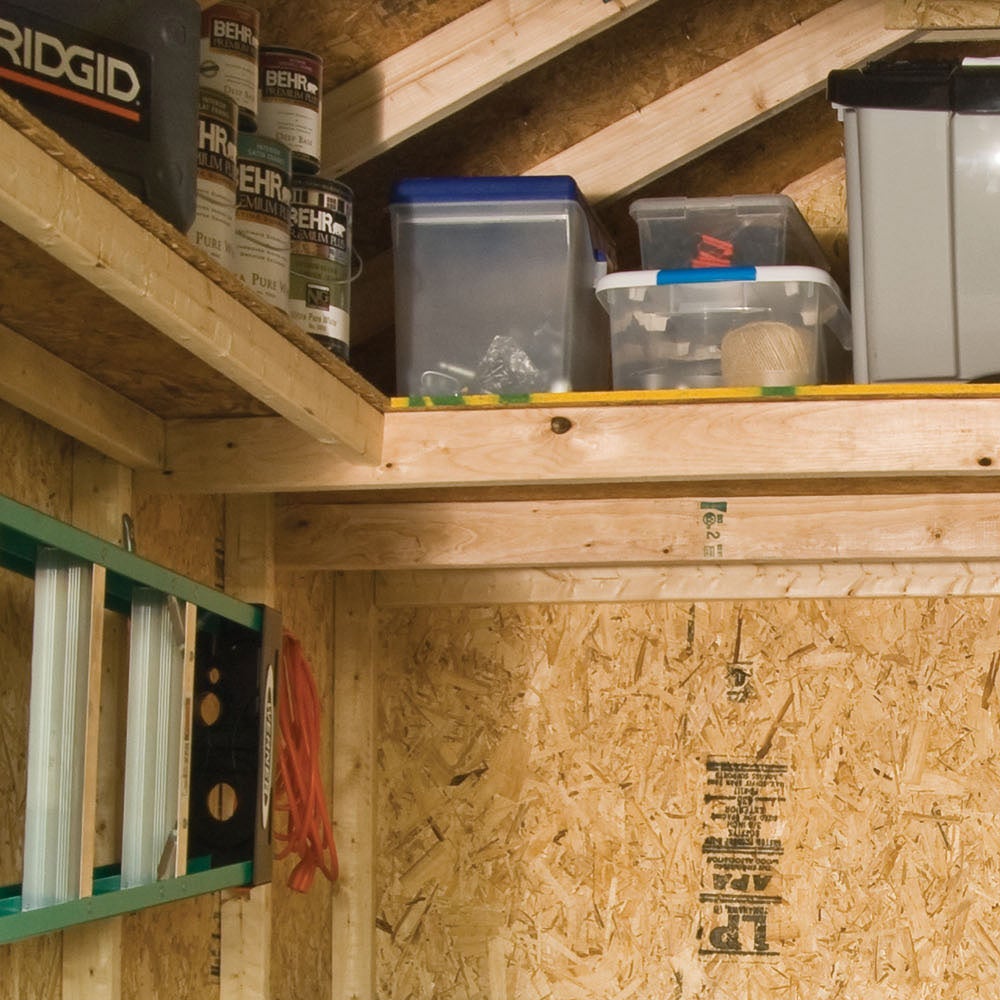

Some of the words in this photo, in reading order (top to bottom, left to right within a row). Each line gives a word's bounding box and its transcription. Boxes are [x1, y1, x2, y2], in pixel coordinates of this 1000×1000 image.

[213, 19, 253, 44] BEHR
[0, 18, 141, 103] RIDGID
[266, 70, 308, 91] BEHR
[199, 120, 229, 159] HR
[239, 164, 285, 203] EHR
[713, 874, 773, 891] APA
[709, 914, 770, 951] LP
